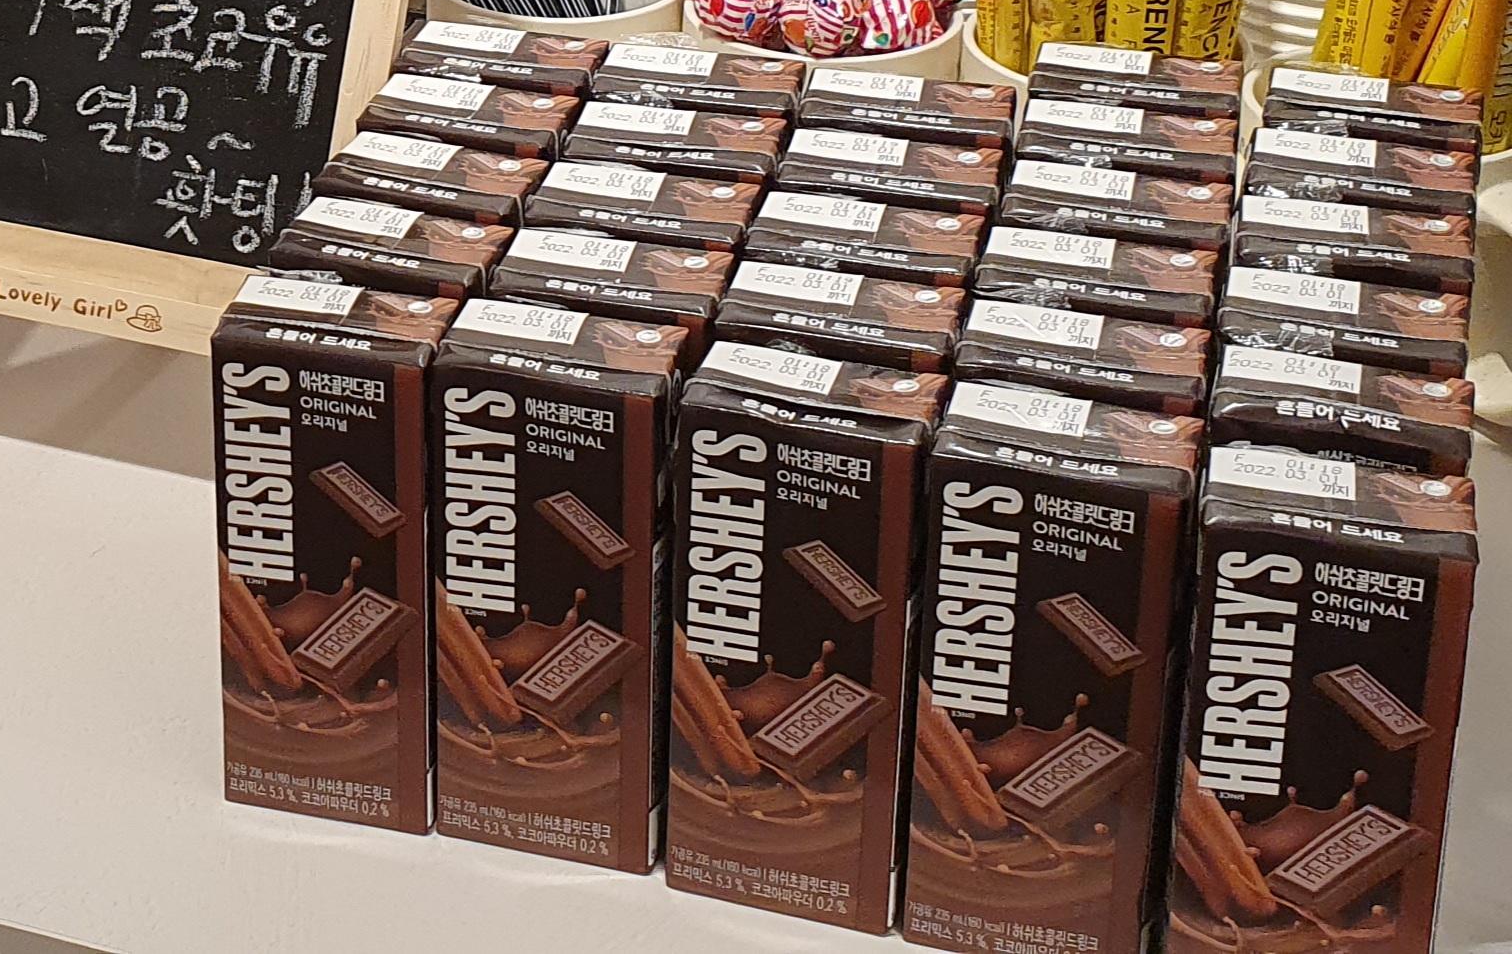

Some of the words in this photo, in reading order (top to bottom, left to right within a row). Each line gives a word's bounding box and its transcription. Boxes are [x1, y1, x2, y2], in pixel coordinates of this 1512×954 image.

[73, 297, 114, 320] Girl
[264, 326, 318, 346] 흔들어
[319, 335, 373, 353] 드세요
[489, 352, 543, 373] 흔들어
[545, 362, 602, 382] 드세요
[297, 369, 385, 403] 허쉬초콜릿드링크
[299, 396, 378, 420] ORIGINAL
[300, 413, 349, 433] 오리지널
[525, 396, 615, 434] 허쉬초콜릿드링크
[799, 413, 859, 430] 드세요
[1274, 399, 1336, 422] 흔들어
[525, 422, 607, 451] ORIGINAL
[525, 440, 576, 462] 오리지널
[222, 362, 294, 582] HERSHEY'S
[776, 442, 872, 483] 허쉬초콜릿드링크
[994, 446, 1054, 468] 흔들어
[1058, 458, 1120, 478] 드세요
[444, 387, 517, 613] HERSHEY'S
[776, 468, 863, 501] ORIGINAL
[776, 486, 829, 512] 오리지널
[1321, 483, 1350, 498] 까지
[1034, 492, 1136, 535] 허쉬초콜릿드링크
[1269, 511, 1333, 534] 흔들어
[1339, 523, 1405, 545] 드세요
[685, 429, 769, 664] HERSHEY'S
[1030, 538, 1089, 563] 오리지널
[1031, 519, 1125, 553] ORIGINAL
[931, 480, 1024, 717] HERSHEY'S
[1313, 561, 1426, 604] 허쉬초콜릿드링크
[1309, 609, 1373, 634] 오리지널
[1310, 590, 1412, 622] ORIGINAL
[313, 601, 385, 661] HERSHEY'S
[533, 631, 610, 694] HERSHEY'S
[1197, 550, 1304, 798] HERSHEY'S
[773, 686, 857, 748] HERSHEY'S
[1022, 739, 1112, 803] HERSHEY'S
[1293, 818, 1392, 885] HERSHEY'S
